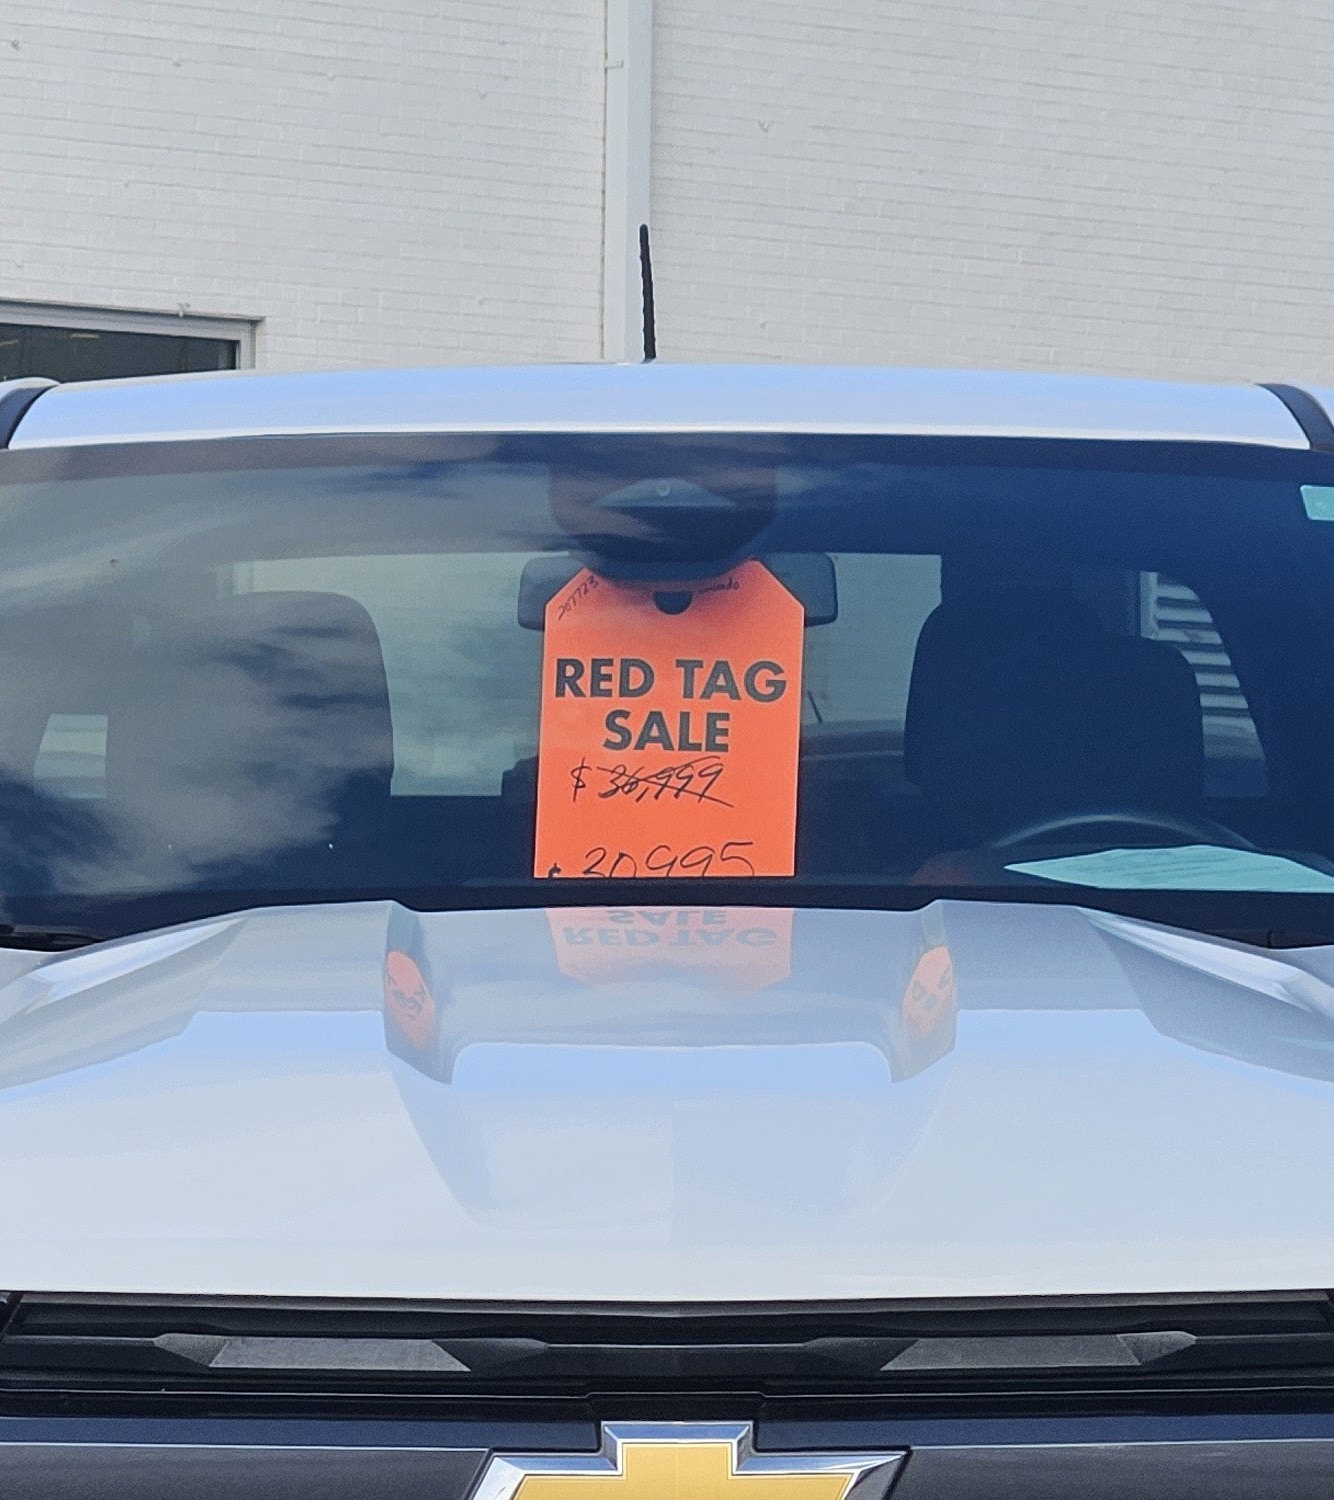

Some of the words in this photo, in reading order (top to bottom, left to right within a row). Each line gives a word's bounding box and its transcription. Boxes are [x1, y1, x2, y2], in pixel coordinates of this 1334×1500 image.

[555, 657, 655, 698] RED
[675, 659, 787, 703] TAG
[602, 709, 731, 752] SALE
